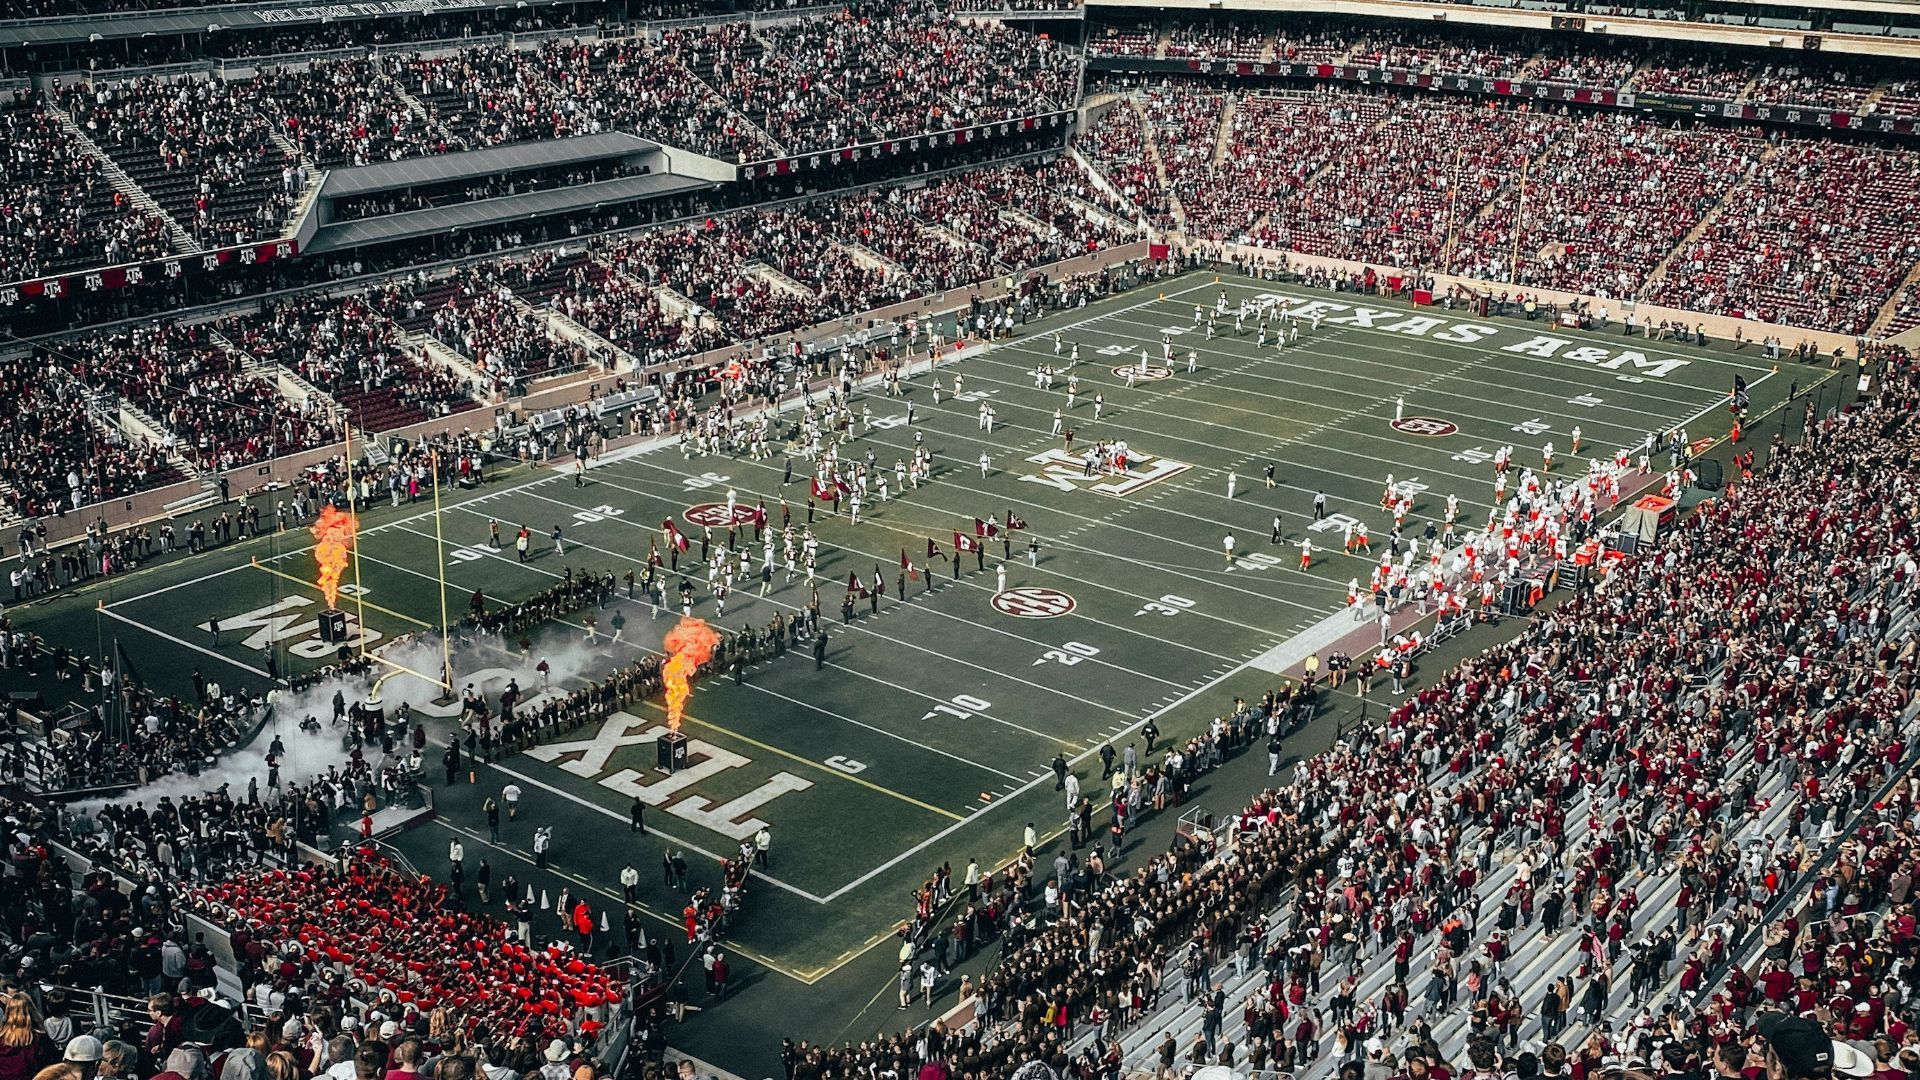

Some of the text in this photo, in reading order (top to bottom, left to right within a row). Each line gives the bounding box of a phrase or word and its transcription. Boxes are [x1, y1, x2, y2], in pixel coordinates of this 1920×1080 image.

[254, 4, 356, 22] WELCOME
[350, 3, 382, 15] TO
[1701, 104, 1716, 112] 2:10
[1254, 293, 1692, 378] TEXAS A&M
[573, 504, 625, 524] 20
[1235, 552, 1281, 570] 40
[1145, 594, 1196, 616] 30
[1044, 641, 1100, 667] 20
[934, 694, 992, 720] 10
[824, 755, 868, 774] G
